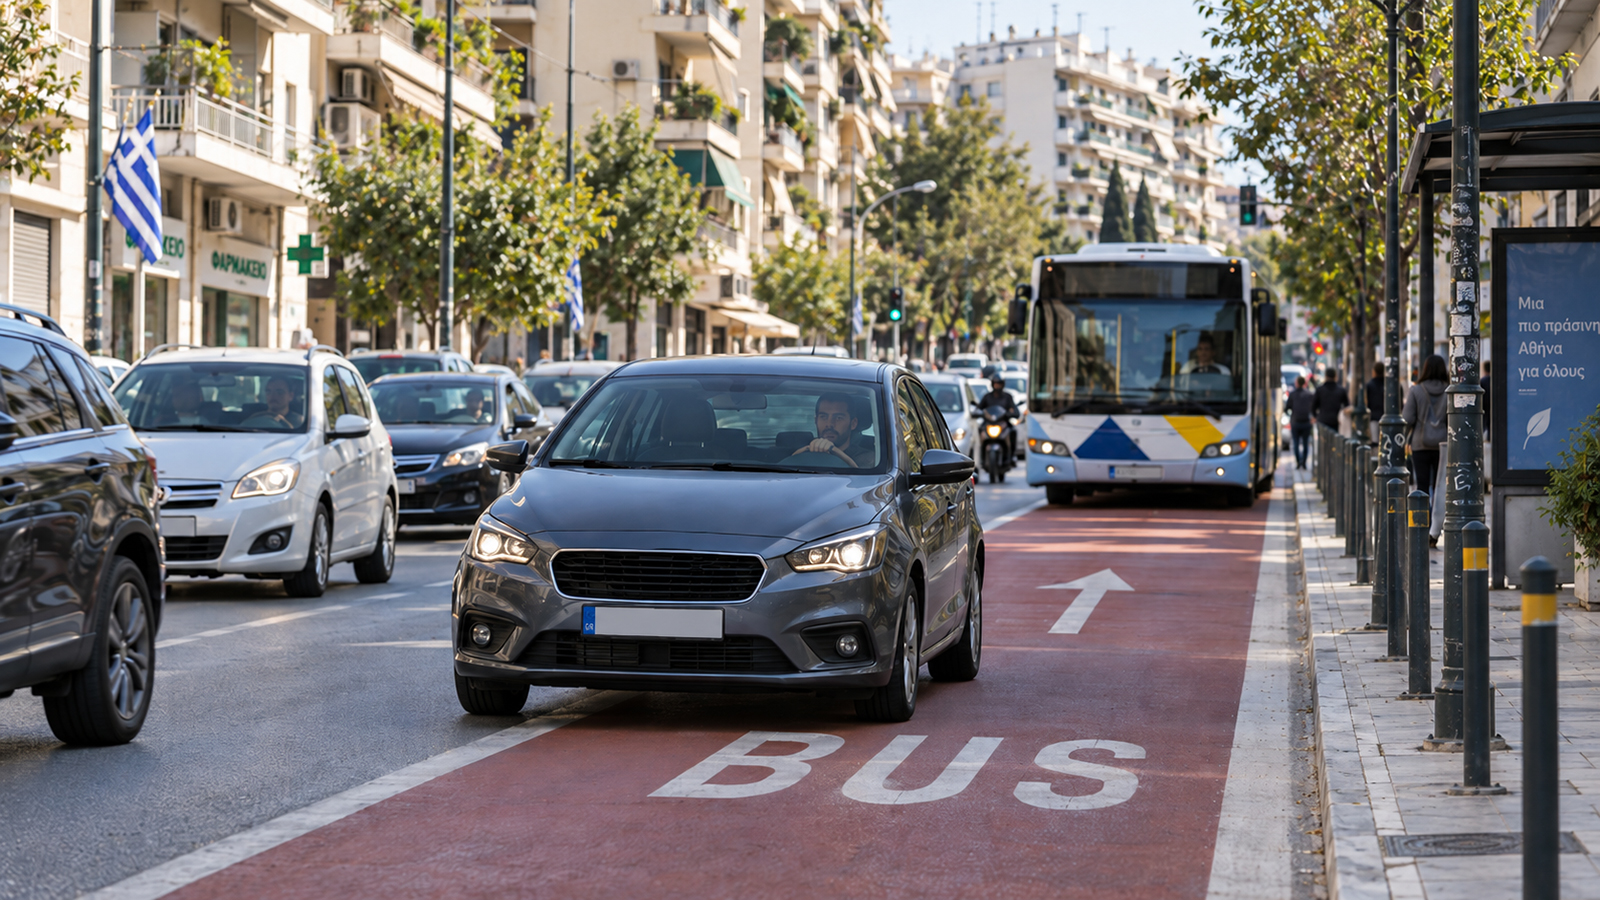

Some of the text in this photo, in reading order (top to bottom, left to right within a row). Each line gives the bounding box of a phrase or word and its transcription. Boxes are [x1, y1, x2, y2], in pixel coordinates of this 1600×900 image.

[211, 250, 267, 281] ΦΑΡΜΑΚΕΙΟ
[1518, 296, 1545, 310] Μια
[1518, 317, 1600, 335] πιο πράσινη
[1518, 340, 1563, 358] Αθήνα
[1518, 363, 1585, 382] για όλους
[646, 730, 1147, 810] BUS
